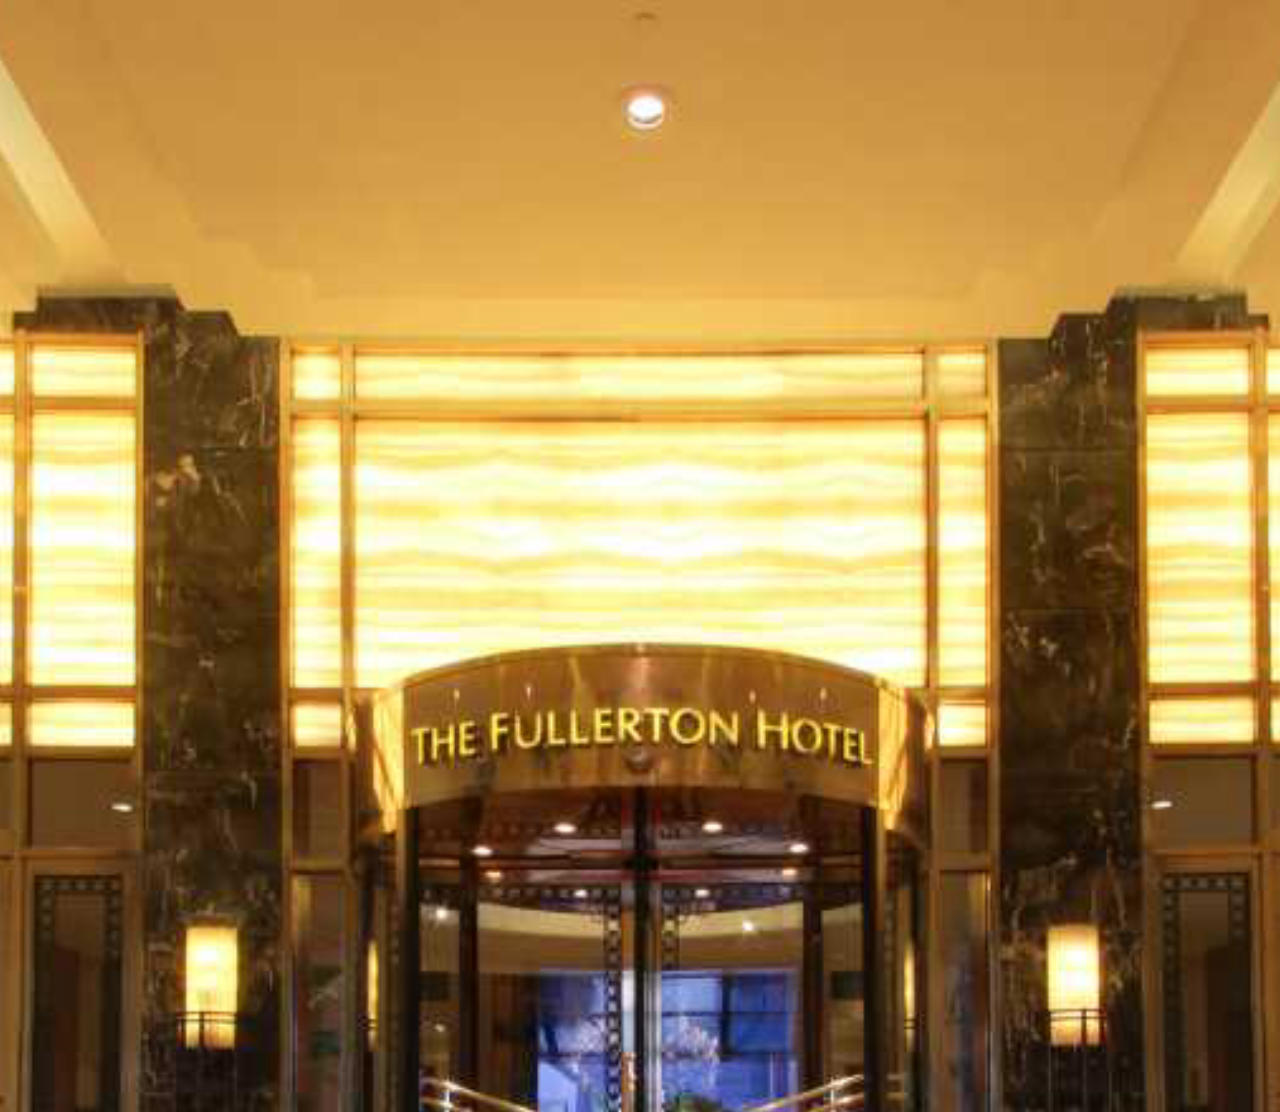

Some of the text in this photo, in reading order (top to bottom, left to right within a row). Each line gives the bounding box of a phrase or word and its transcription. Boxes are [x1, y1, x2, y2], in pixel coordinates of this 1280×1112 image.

[411, 706, 873, 766] THE FULLERTON HOTEL
